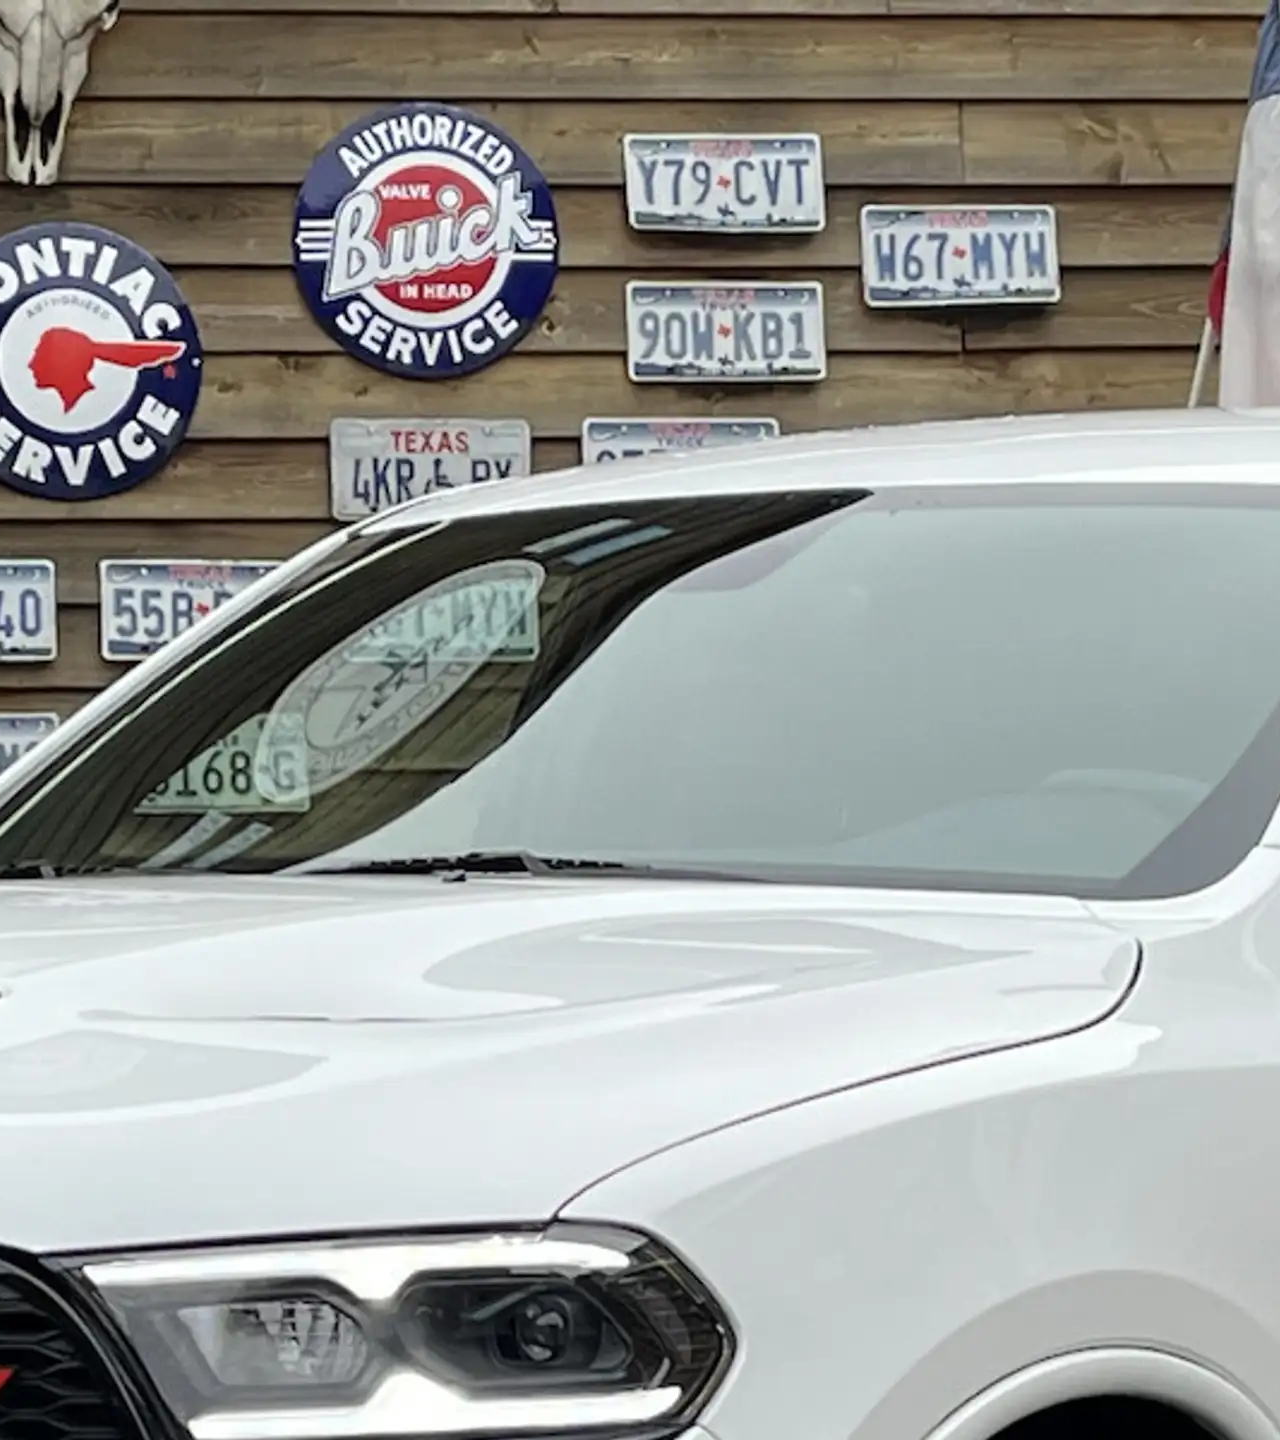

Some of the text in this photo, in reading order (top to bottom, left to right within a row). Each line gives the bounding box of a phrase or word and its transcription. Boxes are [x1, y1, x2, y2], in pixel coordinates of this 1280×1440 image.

[338, 114, 515, 178] AUTHORIZED
[378, 184, 431, 200] VALVE
[637, 158, 810, 206] Y79 CVT
[322, 171, 541, 303] Buick
[400, 284, 473, 299] IN HEAD
[335, 300, 520, 366] SERVICE
[733, 311, 812, 362] KB1
[390, 431, 469, 454] TEXAS
[353, 457, 415, 506] 4KR
